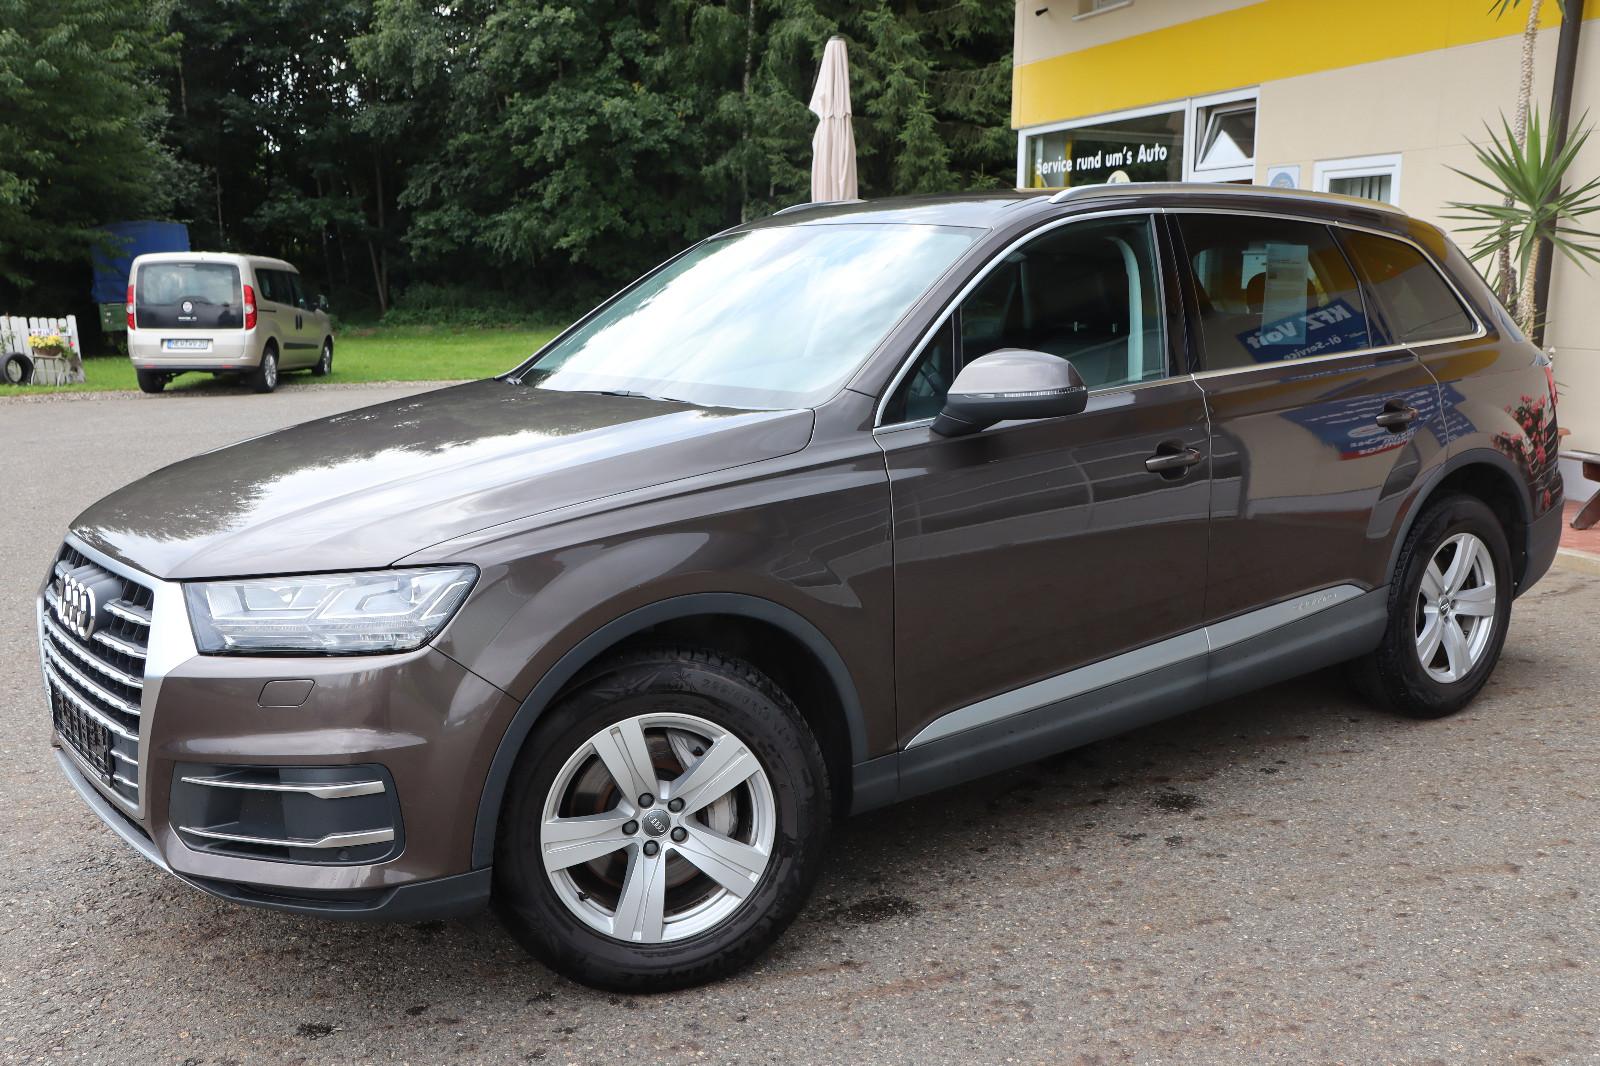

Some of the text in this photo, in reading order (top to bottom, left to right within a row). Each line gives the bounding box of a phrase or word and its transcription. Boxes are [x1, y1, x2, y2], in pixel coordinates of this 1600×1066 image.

[1036, 142, 1168, 175] Service rund um's Auto
